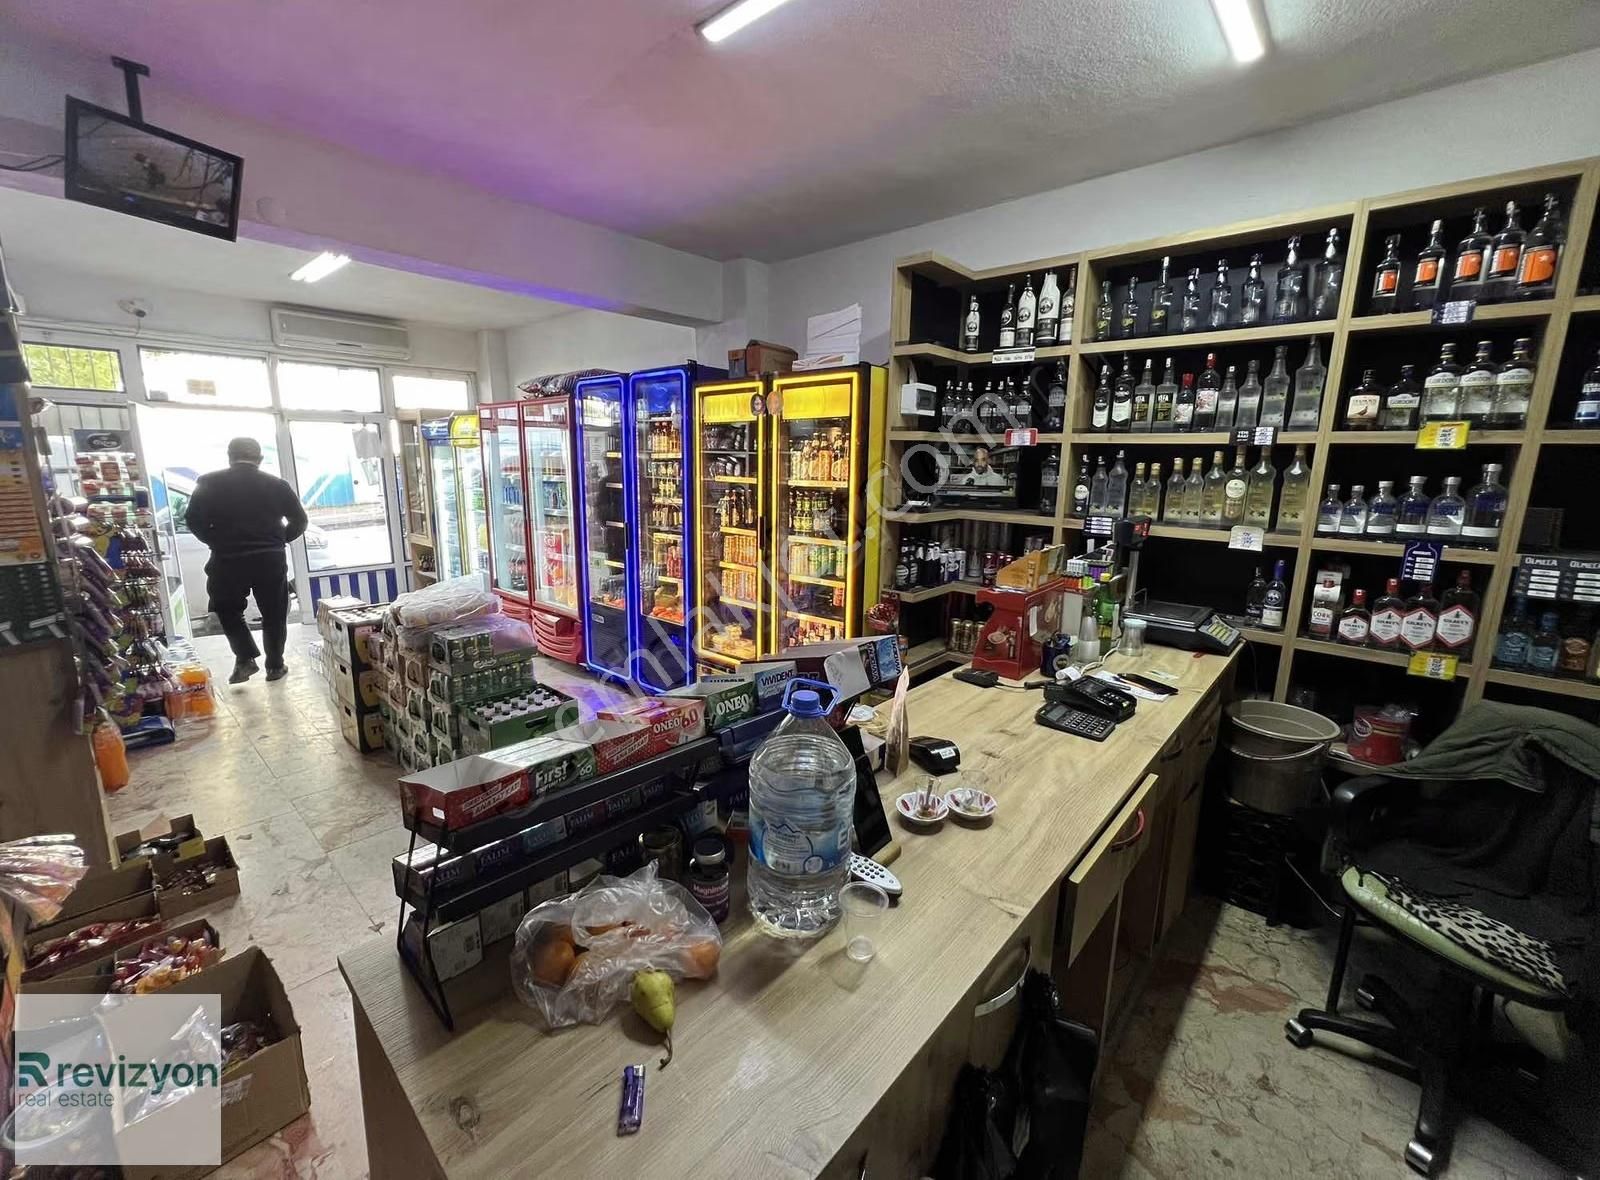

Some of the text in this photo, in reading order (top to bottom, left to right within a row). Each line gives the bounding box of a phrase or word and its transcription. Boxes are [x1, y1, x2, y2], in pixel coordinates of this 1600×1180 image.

[1524, 557, 1558, 567] OLMECA
[761, 669, 794, 687] VIVIDENT
[716, 693, 750, 716] ONEO
[653, 708, 699, 734] ONEO 60
[535, 759, 570, 789] First
[579, 763, 593, 776] 60
